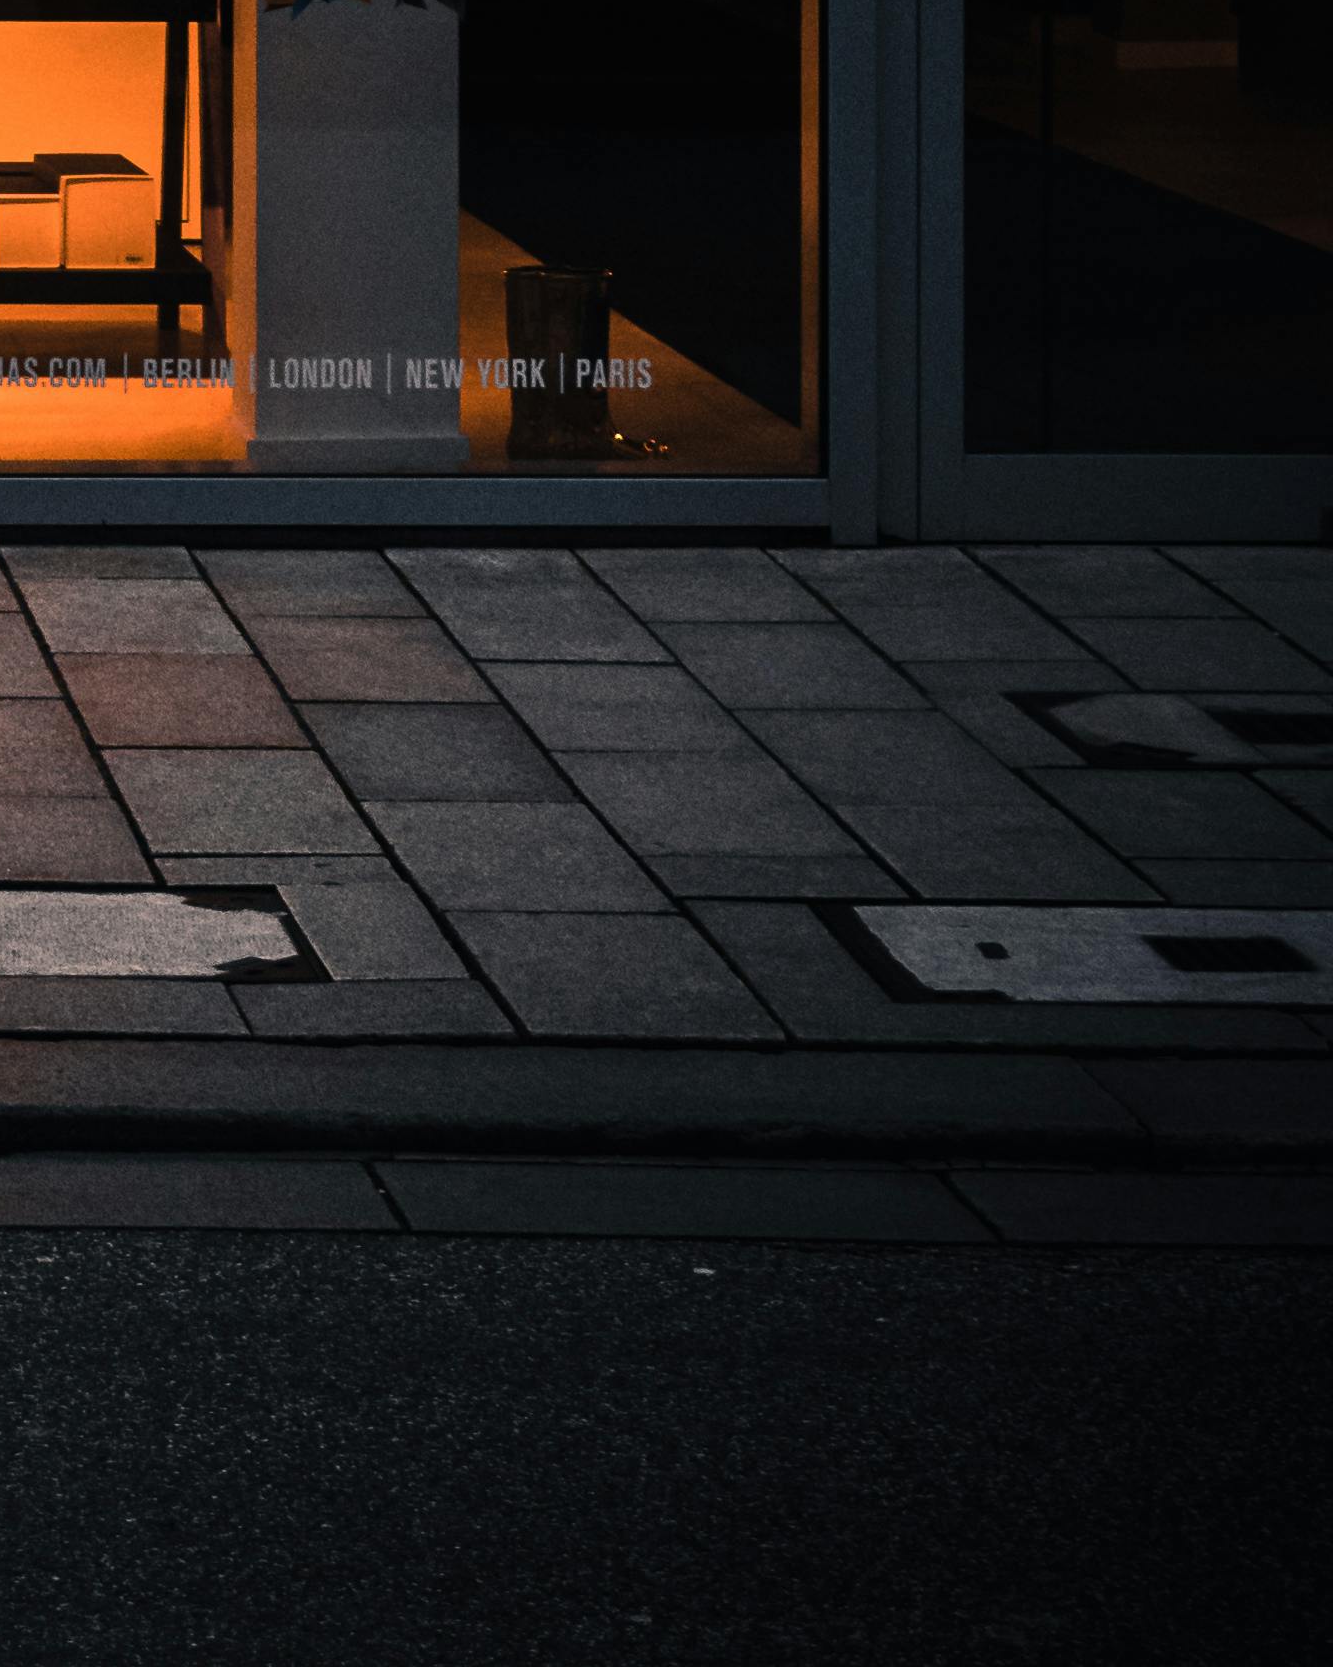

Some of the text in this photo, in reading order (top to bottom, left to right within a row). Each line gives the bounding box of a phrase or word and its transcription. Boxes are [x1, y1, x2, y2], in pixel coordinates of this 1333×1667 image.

[142, 356, 236, 389] BERLIN
[269, 357, 373, 390] LONDON
[404, 357, 466, 390] NEW
[476, 357, 547, 390] YORK
[575, 357, 654, 390] PARIS
